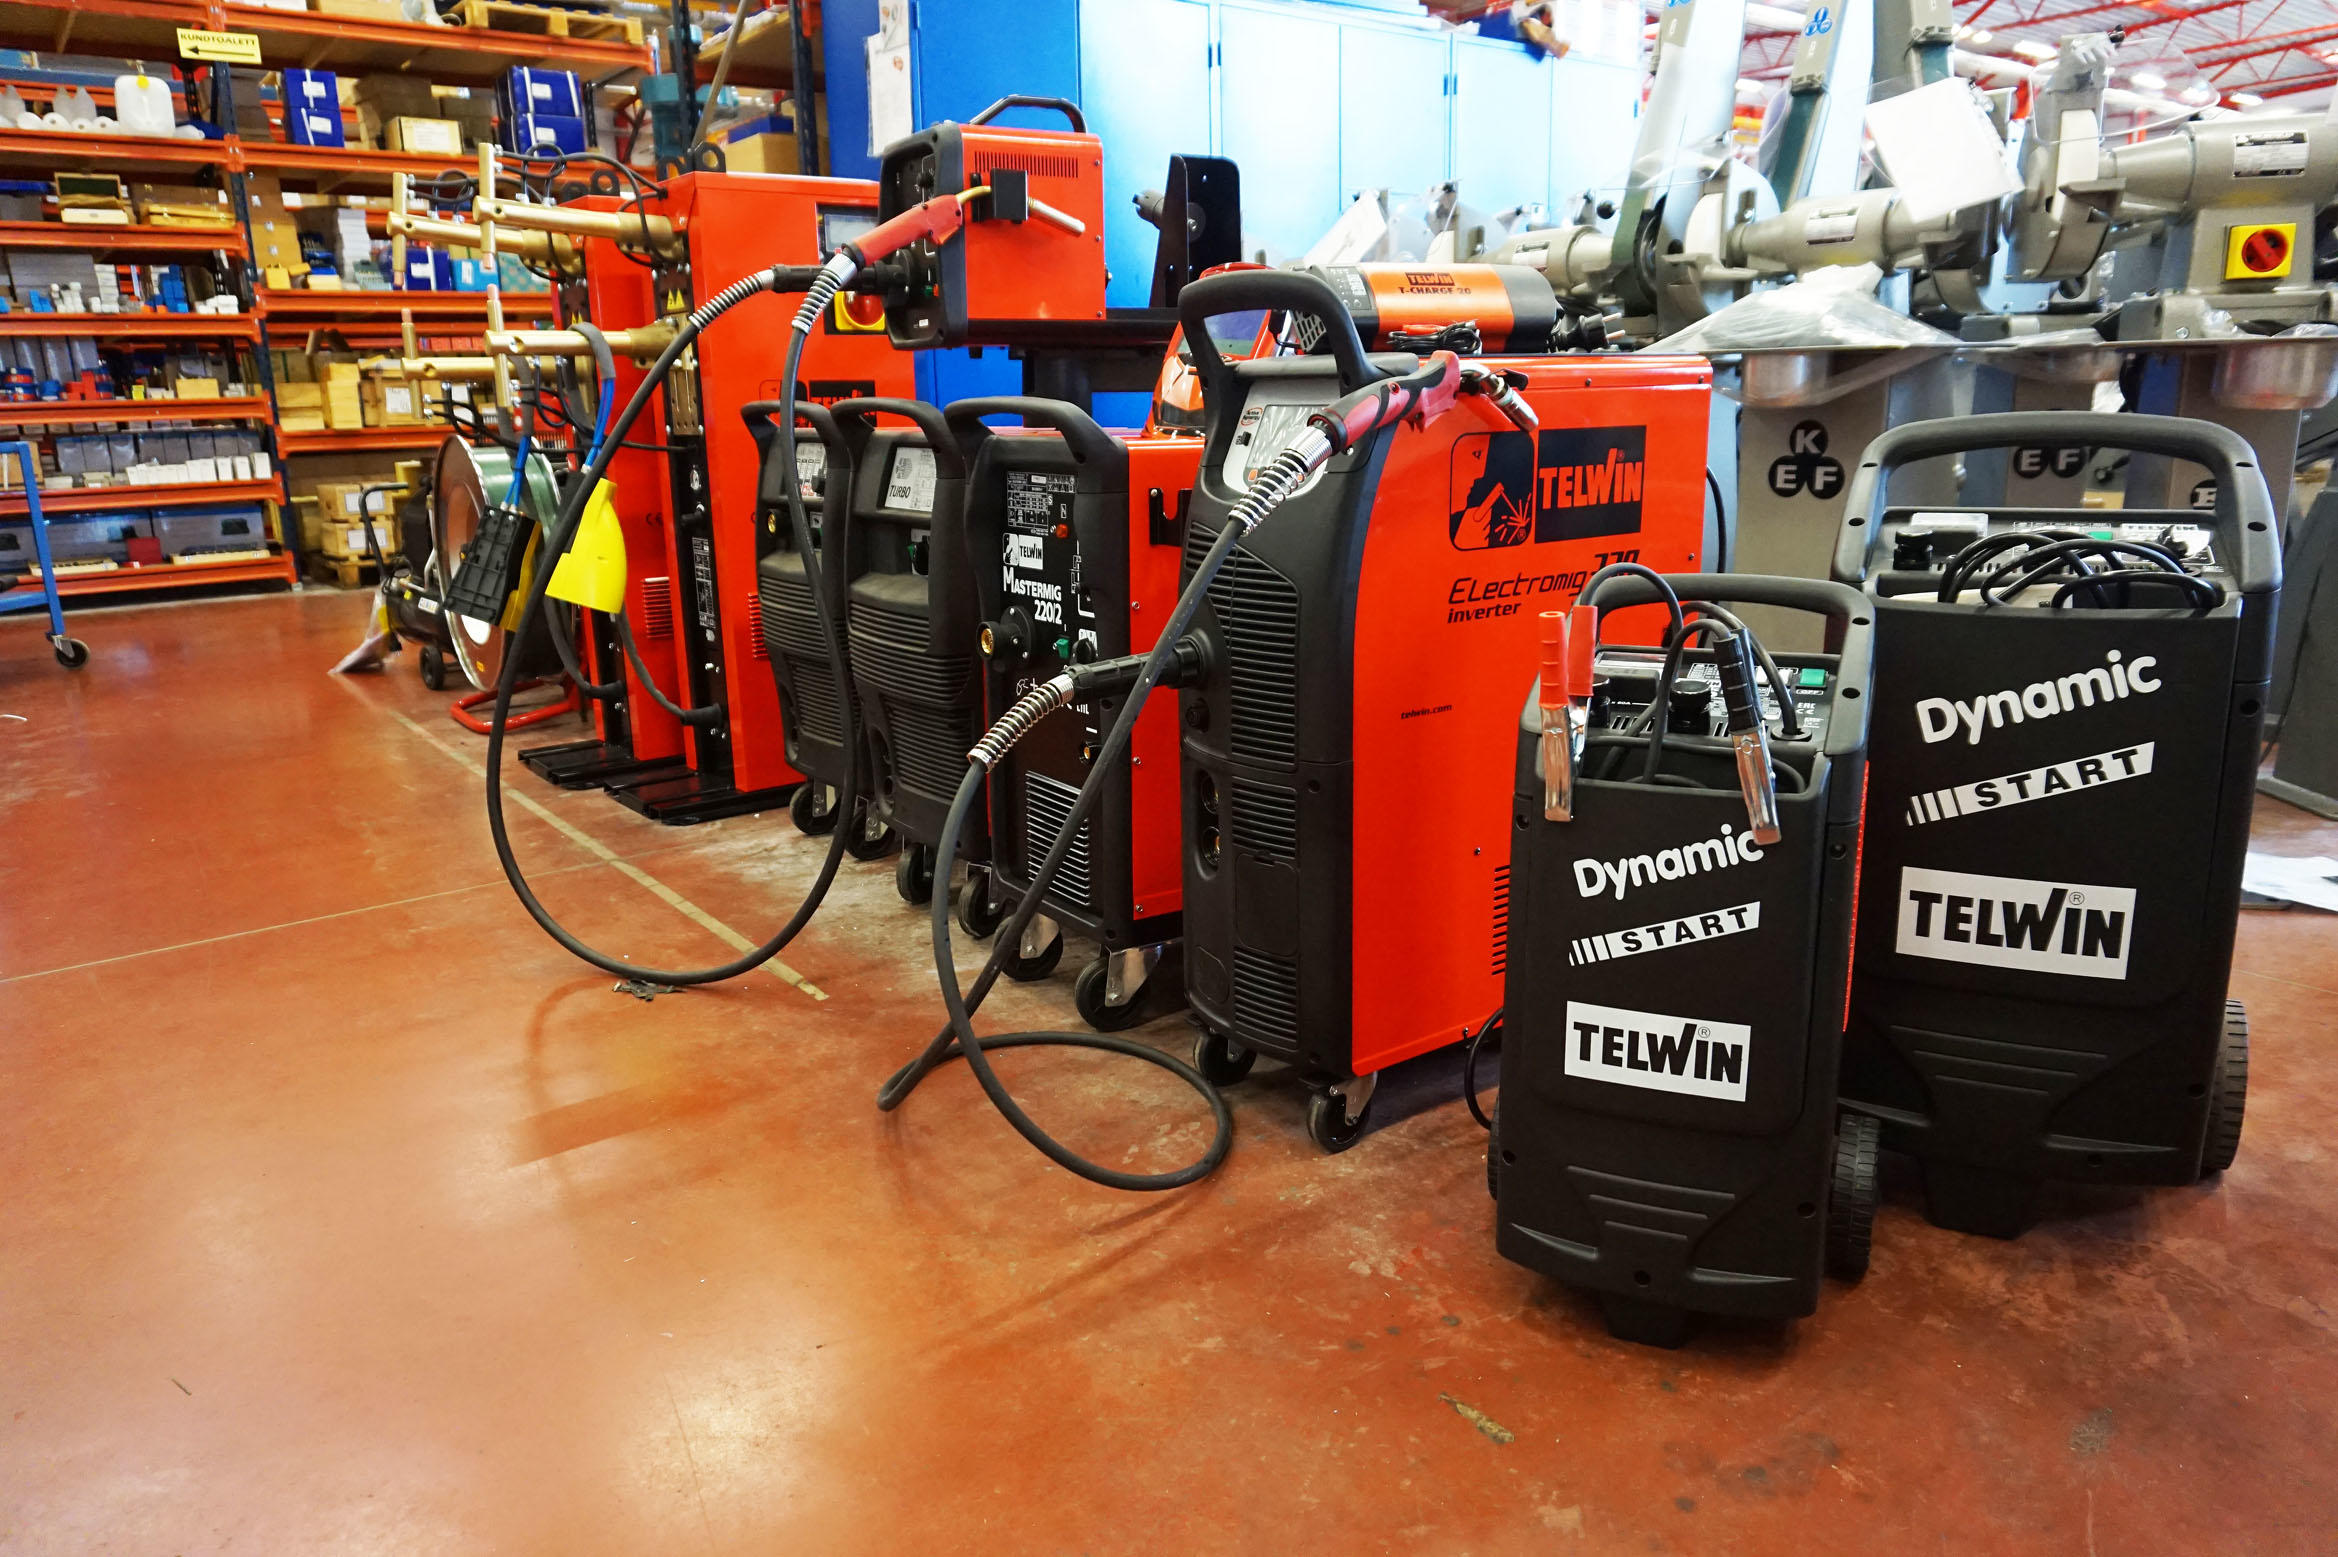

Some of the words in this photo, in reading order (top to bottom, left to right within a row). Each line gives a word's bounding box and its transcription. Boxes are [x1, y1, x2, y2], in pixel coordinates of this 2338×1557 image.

[180, 32, 256, 46] KUNDTOALETT
[1399, 286, 1453, 295] T-CHARGE
[888, 484, 912, 499] TURBO
[1539, 447, 1644, 511] TELWIN
[1019, 542, 1043, 560] TELWIN
[1034, 599, 1063, 625] 220/2
[1447, 602, 1522, 624] inverter
[1400, 704, 1453, 720] telwin.com
[1915, 649, 2162, 746] Dynamic
[1975, 747, 2141, 808] START
[1573, 823, 1765, 900] Dynamic
[1621, 906, 1749, 953] START
[1909, 887, 2127, 960] TELWIN
[1572, 1021, 1744, 1085] TELWIN
